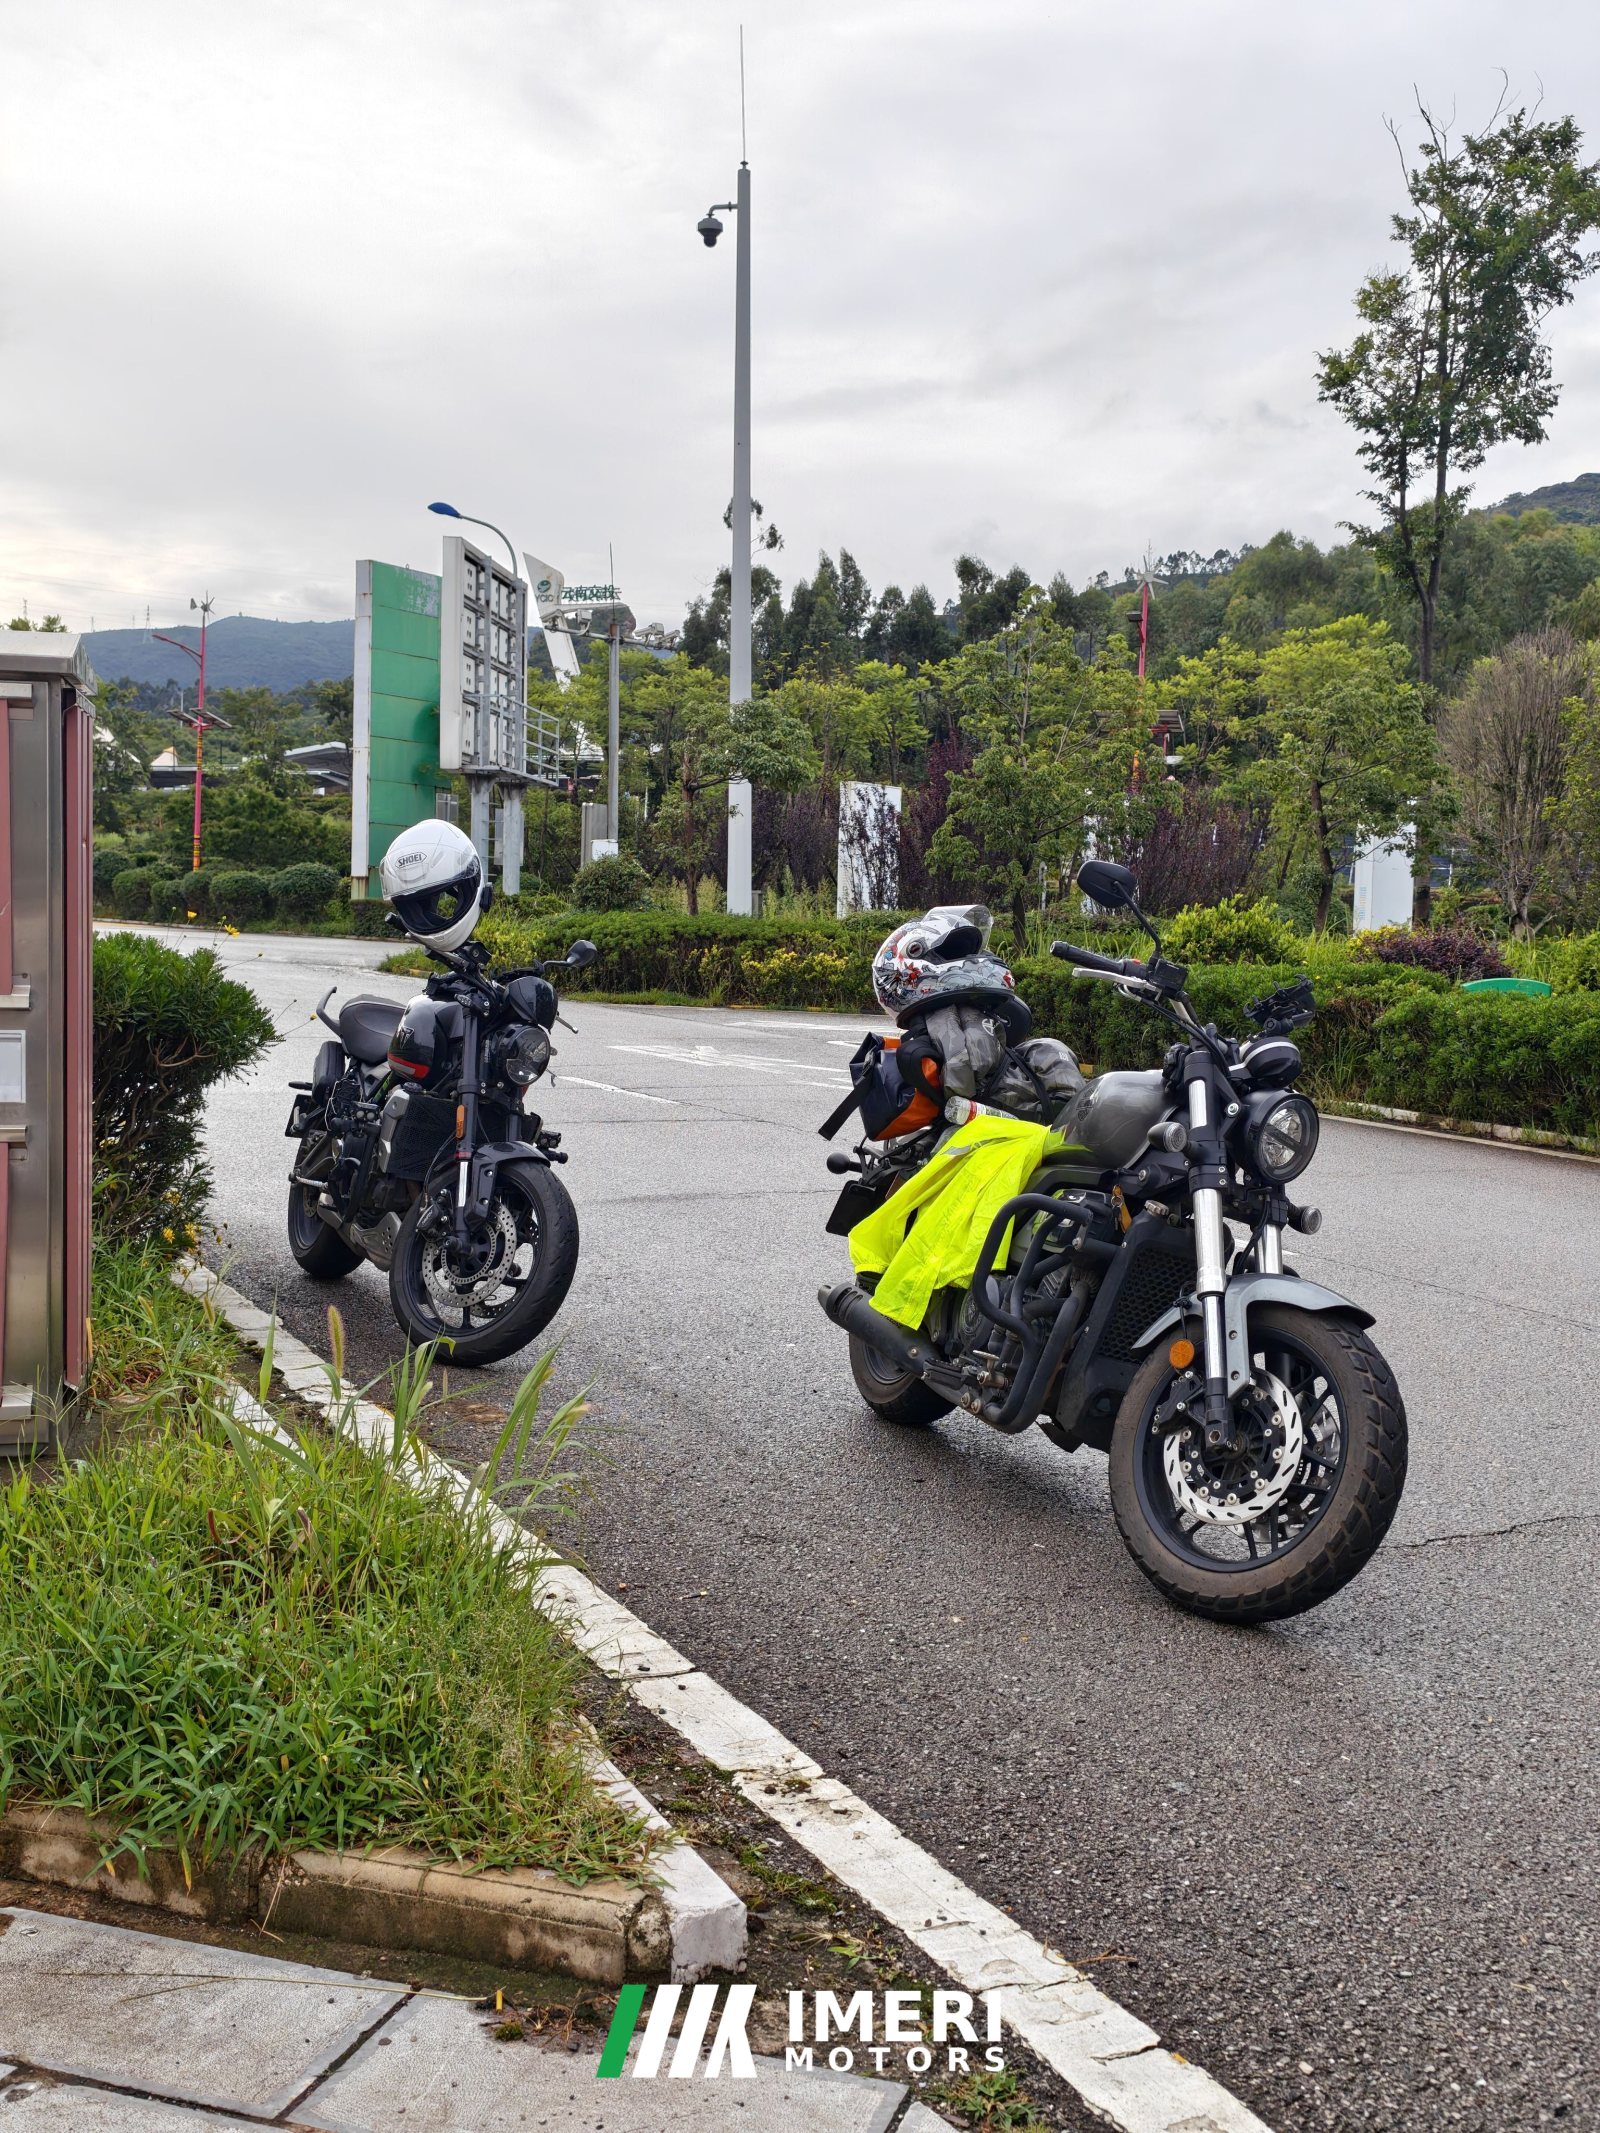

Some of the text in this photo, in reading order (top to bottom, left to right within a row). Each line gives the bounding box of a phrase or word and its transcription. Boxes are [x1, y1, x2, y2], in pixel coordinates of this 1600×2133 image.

[561, 584, 615, 602] 云南交投
[397, 853, 422, 867] SHOEI
